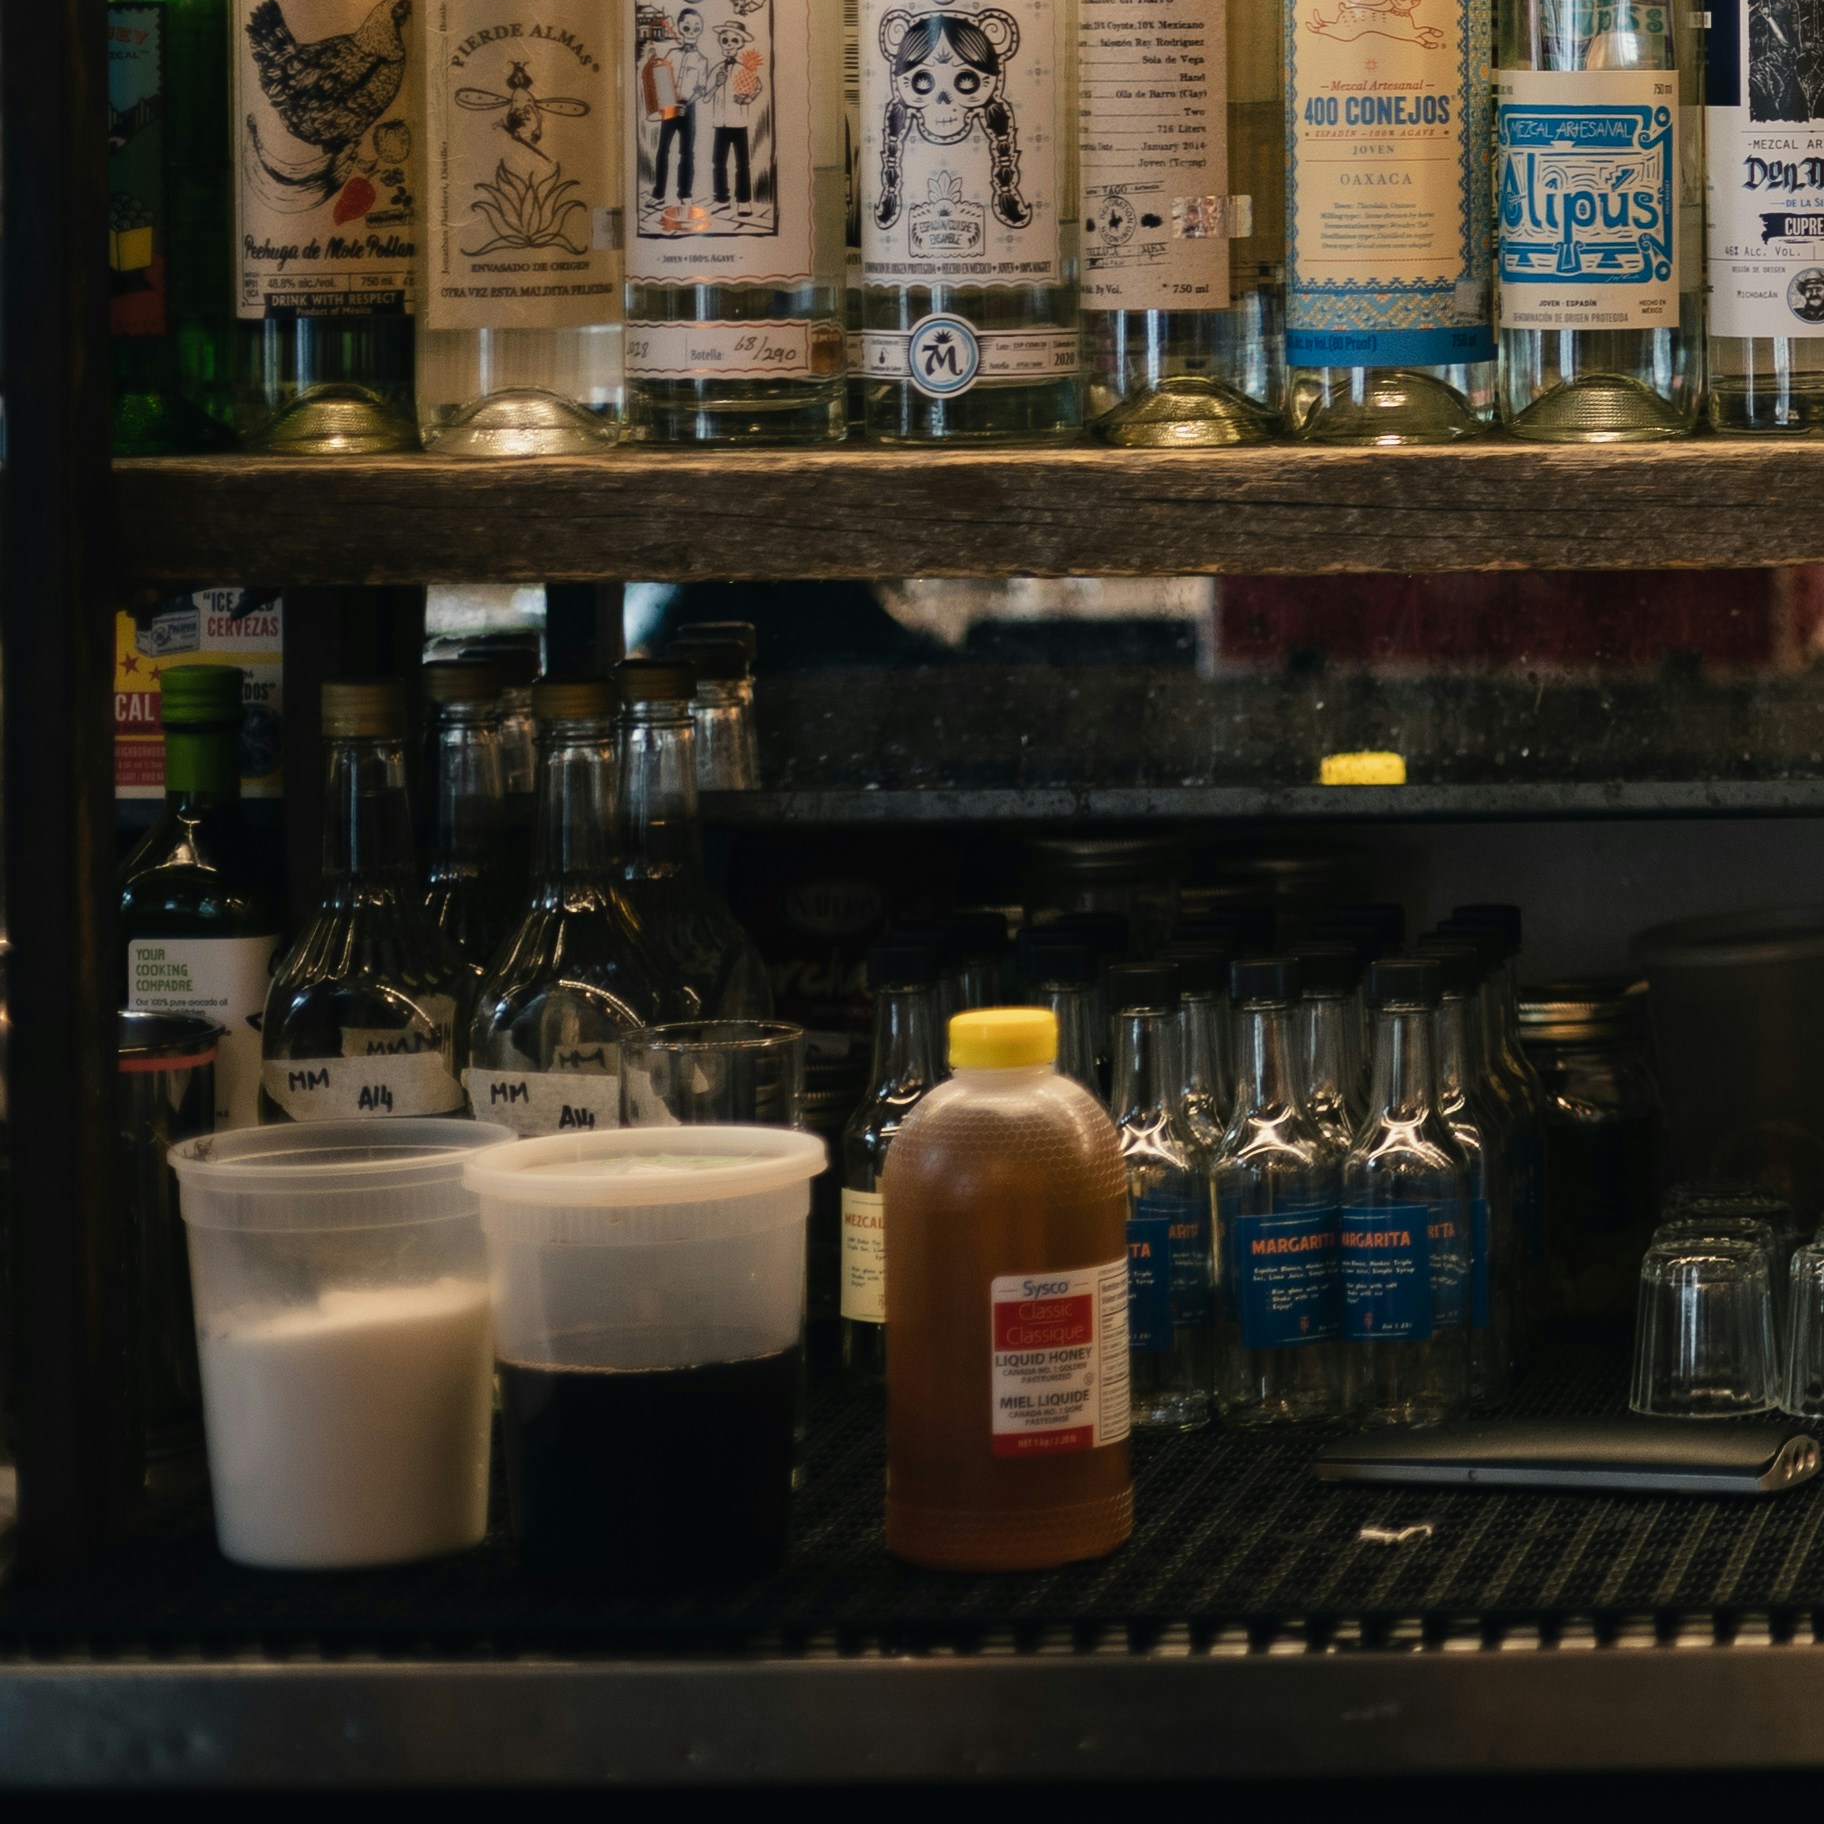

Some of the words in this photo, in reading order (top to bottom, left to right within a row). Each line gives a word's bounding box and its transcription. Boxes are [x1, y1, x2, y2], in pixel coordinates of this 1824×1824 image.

[451, 24, 523, 69] PIERDE
[529, 25, 593, 66] ALMAS
[1331, 79, 1366, 93] Mezcal
[1369, 79, 1423, 91] Artesanal
[1304, 97, 1338, 126] 400
[1346, 95, 1450, 125] CONEJOS
[1511, 120, 1549, 138] MEZCAL
[1555, 120, 1632, 143] ARTESANAL
[1352, 145, 1395, 156] JOVEN
[1340, 173, 1413, 186] OAXACA
[1745, 154, 1795, 193] Don
[136, 948, 166, 962] YOUR
[136, 964, 189, 978] COOKING
[136, 978, 194, 994] COMPADRE
[288, 1070, 330, 1091] MM
[490, 1082, 530, 1104] MM
[1023, 1280, 1068, 1298] Sysco
[1019, 1302, 1073, 1320] Classic
[1006, 1326, 1084, 1345] Classique
[995, 1353, 1045, 1367] LIQUID
[1049, 1347, 1092, 1362] HONEY
[1001, 1395, 1034, 1409] MIEL
[1039, 1389, 1090, 1405] LIQUIDE
